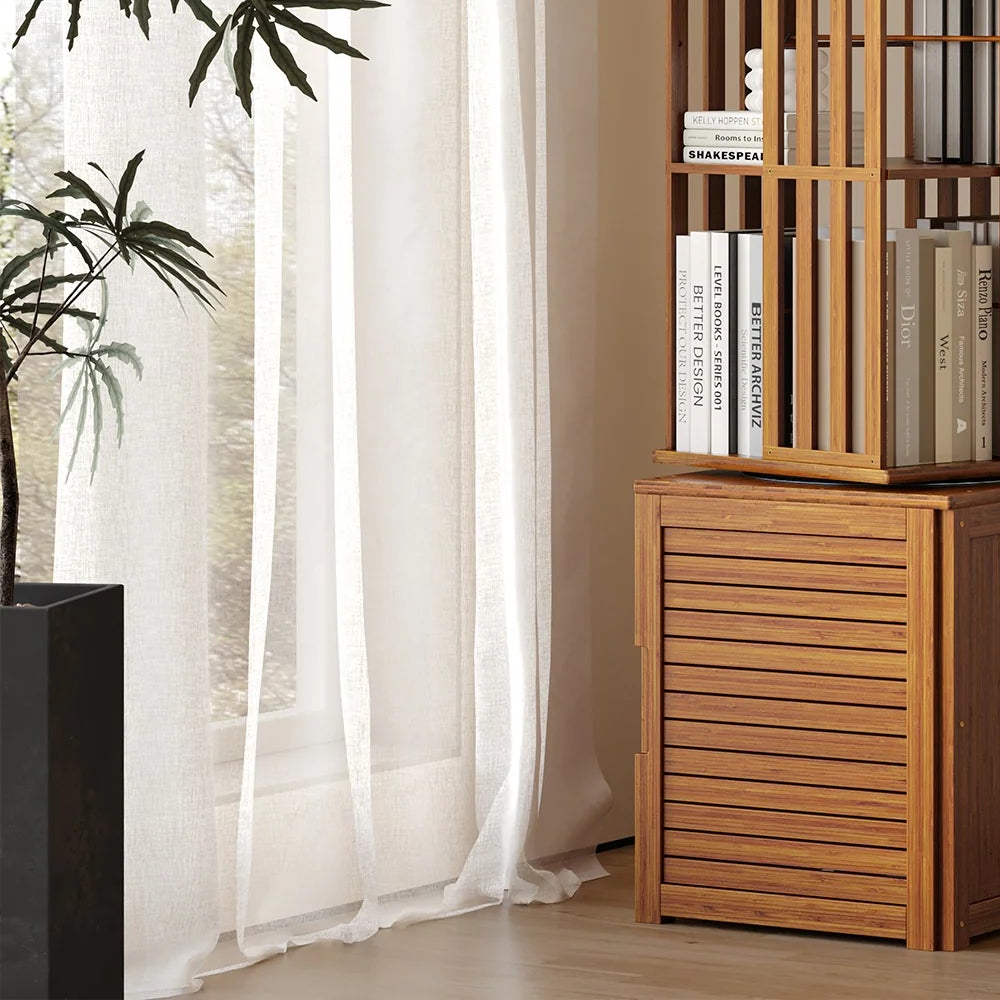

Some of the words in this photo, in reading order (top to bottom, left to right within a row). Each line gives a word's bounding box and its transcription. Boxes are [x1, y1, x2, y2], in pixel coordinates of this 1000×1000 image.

[693, 115, 715, 125] KELLY
[718, 117, 749, 126] HOPPEN
[751, 117, 761, 126] ST
[715, 134, 741, 142] Rooms
[714, 265, 722, 298] LEVEL
[979, 268, 992, 304] Renzo
[679, 270, 687, 335] PROTECT
[693, 285, 703, 341] BETTER
[714, 301, 722, 341] BOOKS
[957, 290, 967, 317] Siza
[752, 302, 761, 361] BETTER
[901, 304, 916, 348] Dior
[979, 307, 992, 340] Piano
[679, 337, 687, 367] OUR
[714, 350, 722, 388] SERIES
[940, 334, 949, 370] West
[693, 347, 703, 407] DESIGN
[679, 372, 687, 423] DESIGN
[714, 391, 722, 410] 001
[752, 364, 761, 428] ARCHVIZ
